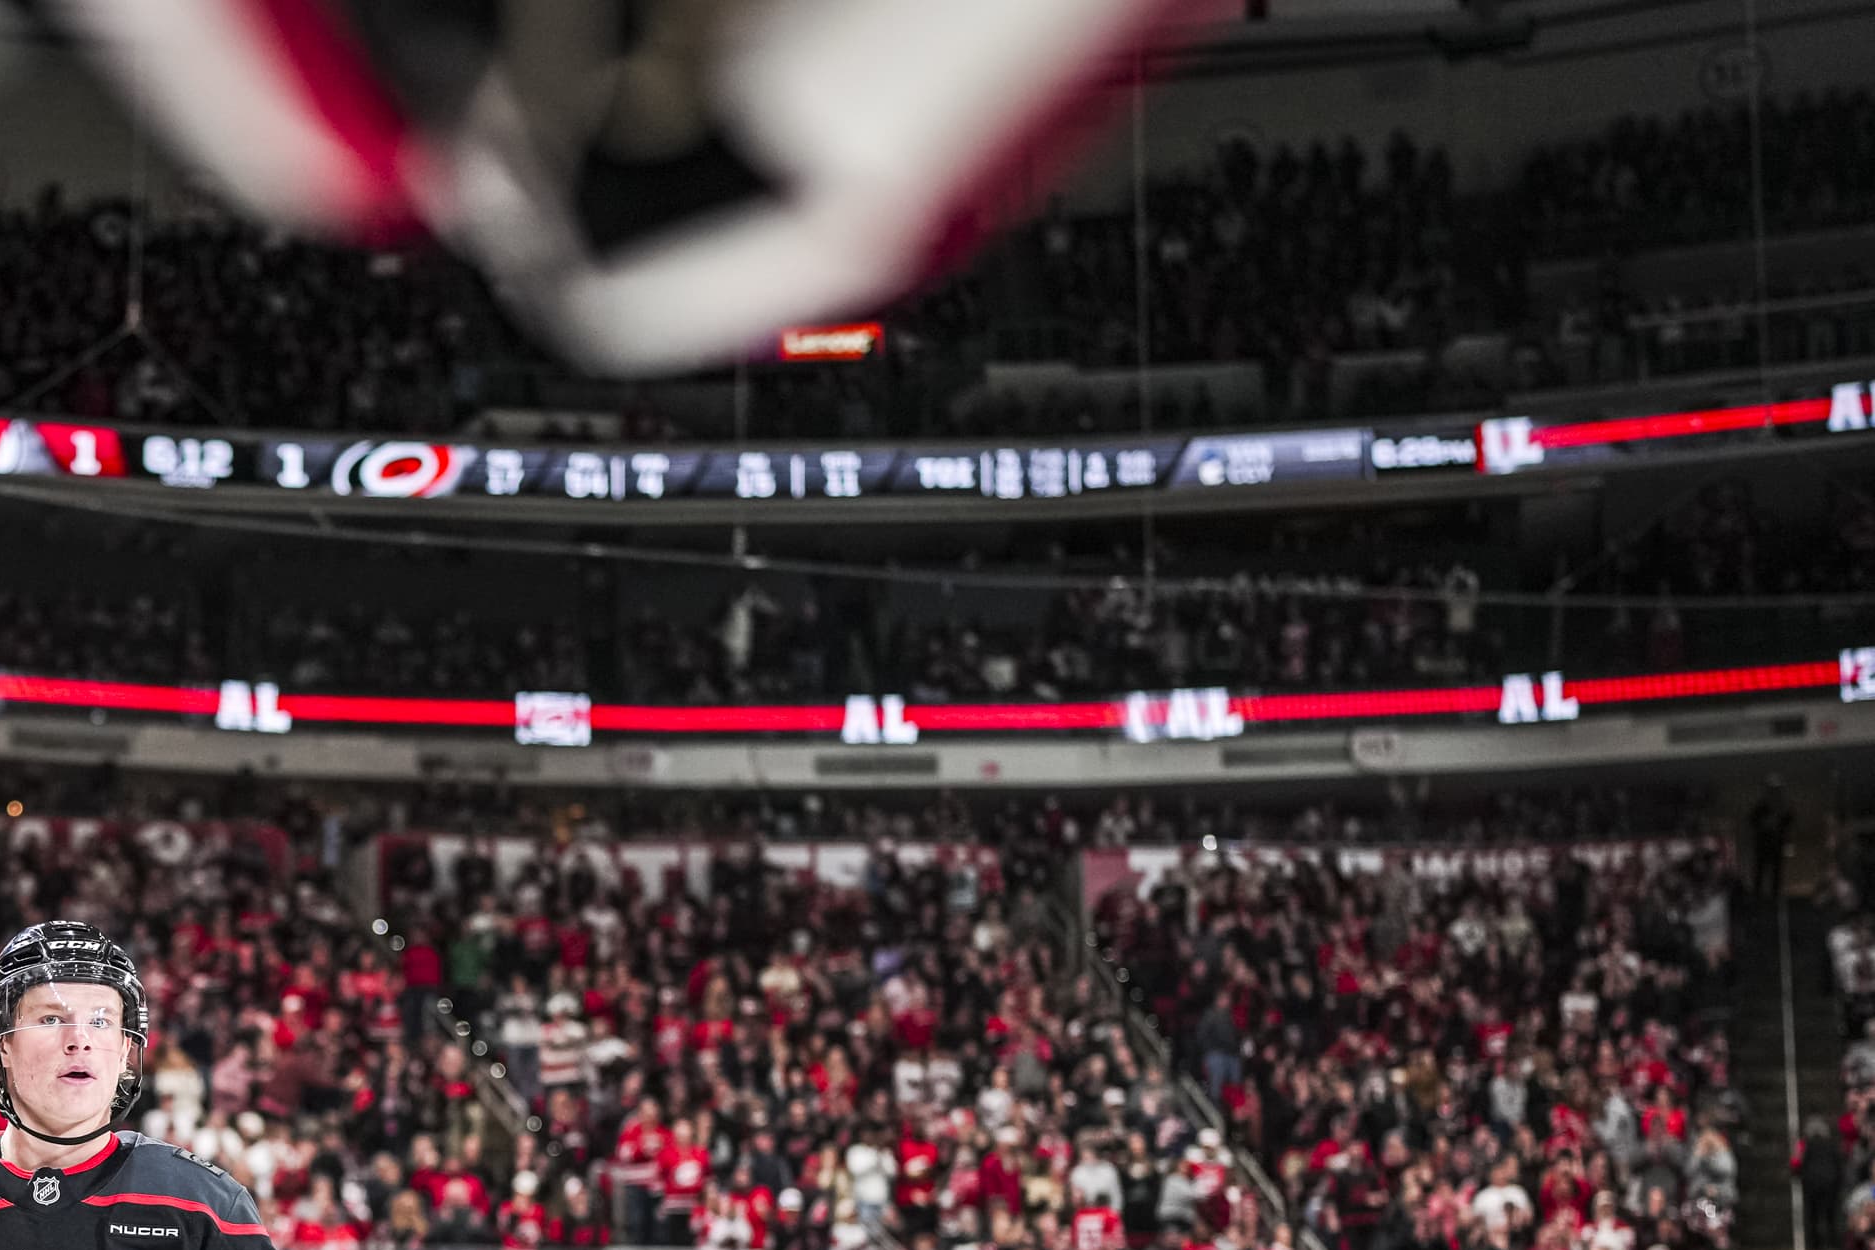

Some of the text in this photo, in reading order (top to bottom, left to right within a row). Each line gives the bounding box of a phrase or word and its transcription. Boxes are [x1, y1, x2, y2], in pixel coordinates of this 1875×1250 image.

[276, 443, 310, 489] 1
[46, 940, 102, 951] CCM
[109, 1224, 179, 1237] NUCOR
